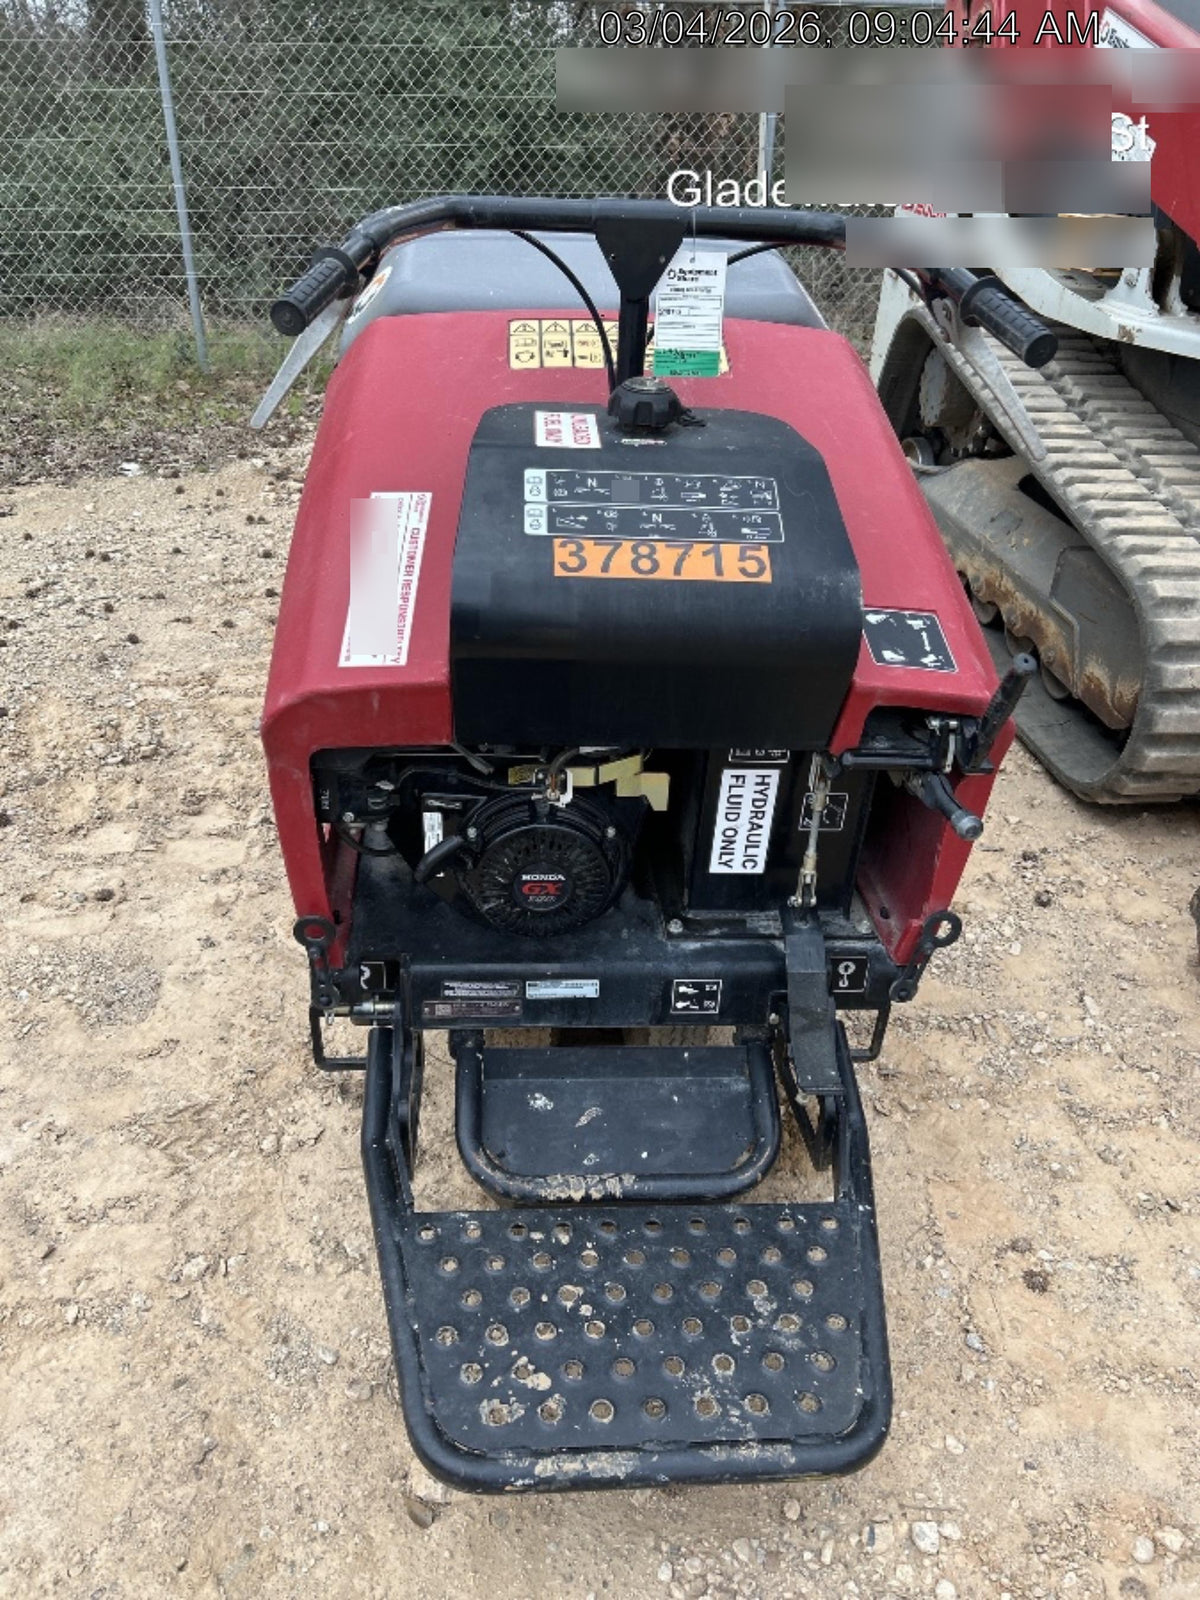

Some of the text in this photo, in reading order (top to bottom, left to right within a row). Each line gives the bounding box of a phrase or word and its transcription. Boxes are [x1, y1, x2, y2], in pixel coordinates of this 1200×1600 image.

[557, 538, 767, 579] 378715
[718, 774, 746, 869] FLUID ONLY
[741, 774, 772, 870] HYDRAULIC
[521, 873, 566, 881] HONDA
[522, 882, 563, 896] GX
